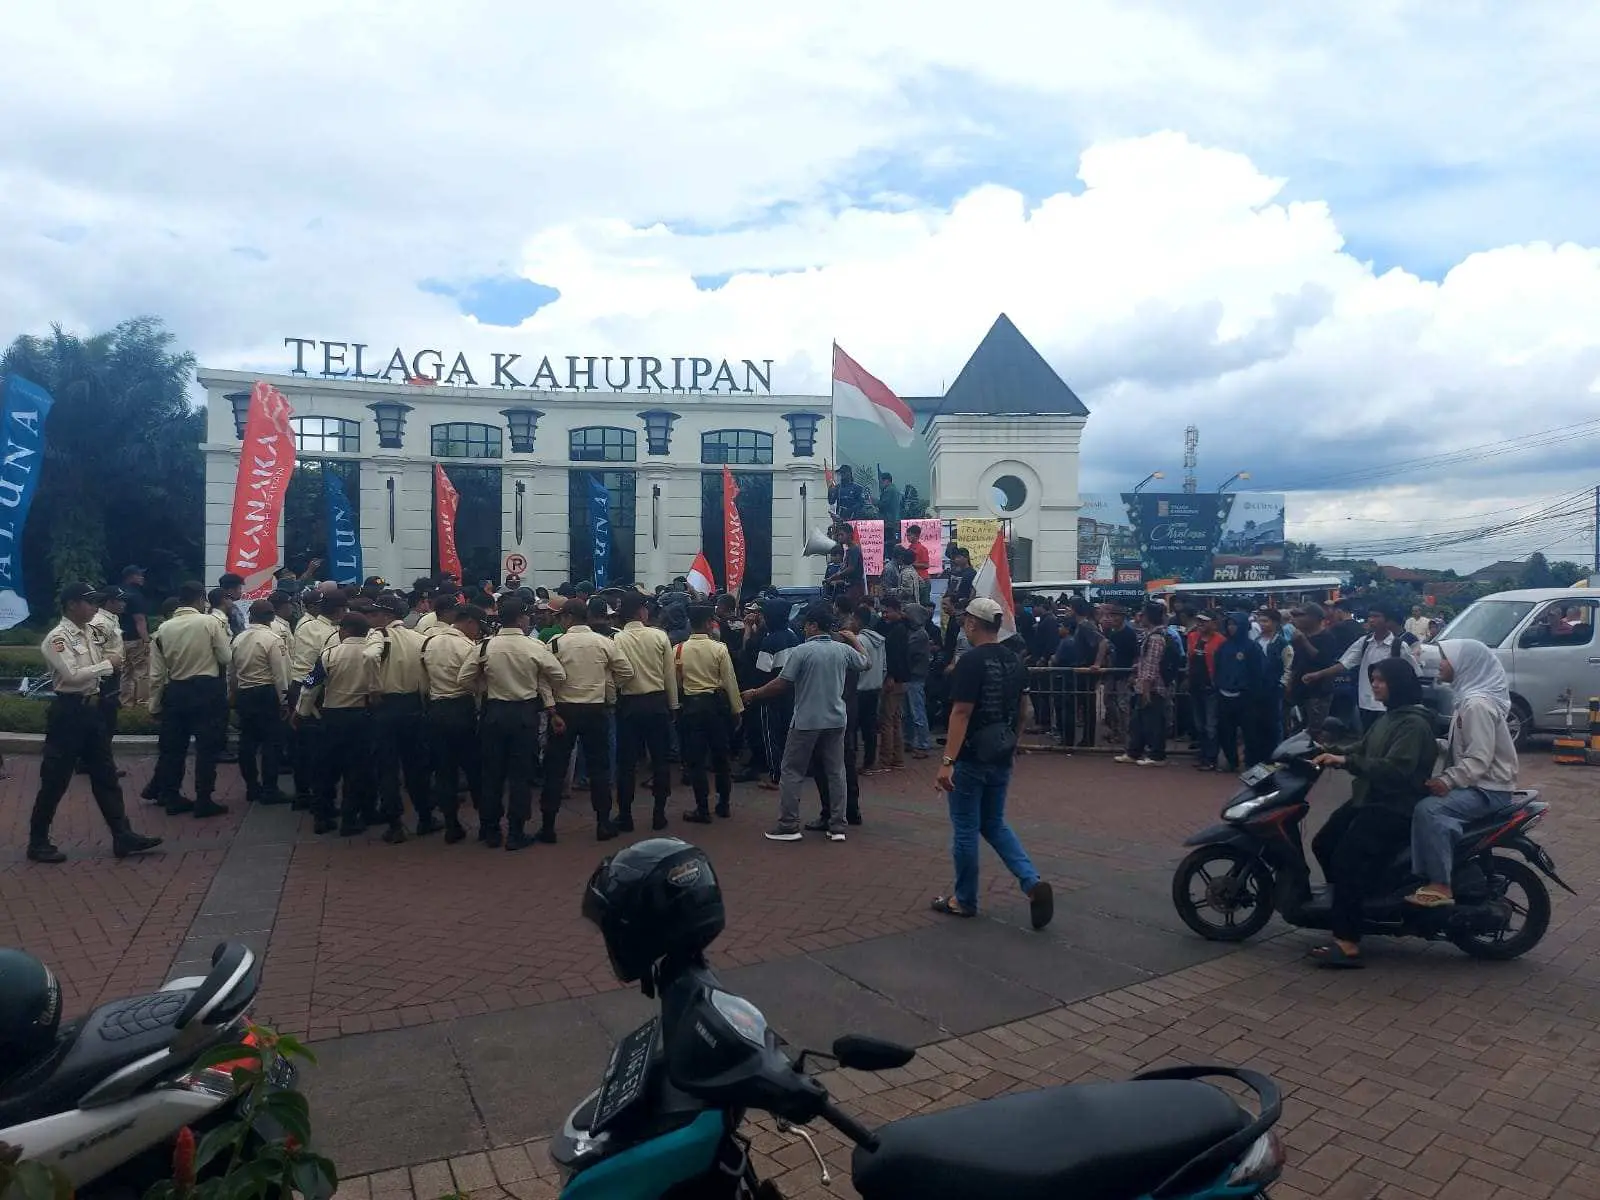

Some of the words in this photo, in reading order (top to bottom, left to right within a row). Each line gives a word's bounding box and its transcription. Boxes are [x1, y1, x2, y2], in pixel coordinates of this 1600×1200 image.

[285, 337, 478, 386] TELAGA
[490, 353, 775, 394] KAHURIPAN
[0, 409, 39, 582] ALUNA
[235, 435, 278, 570] KANAKA
[1213, 568, 1239, 580] PPN
